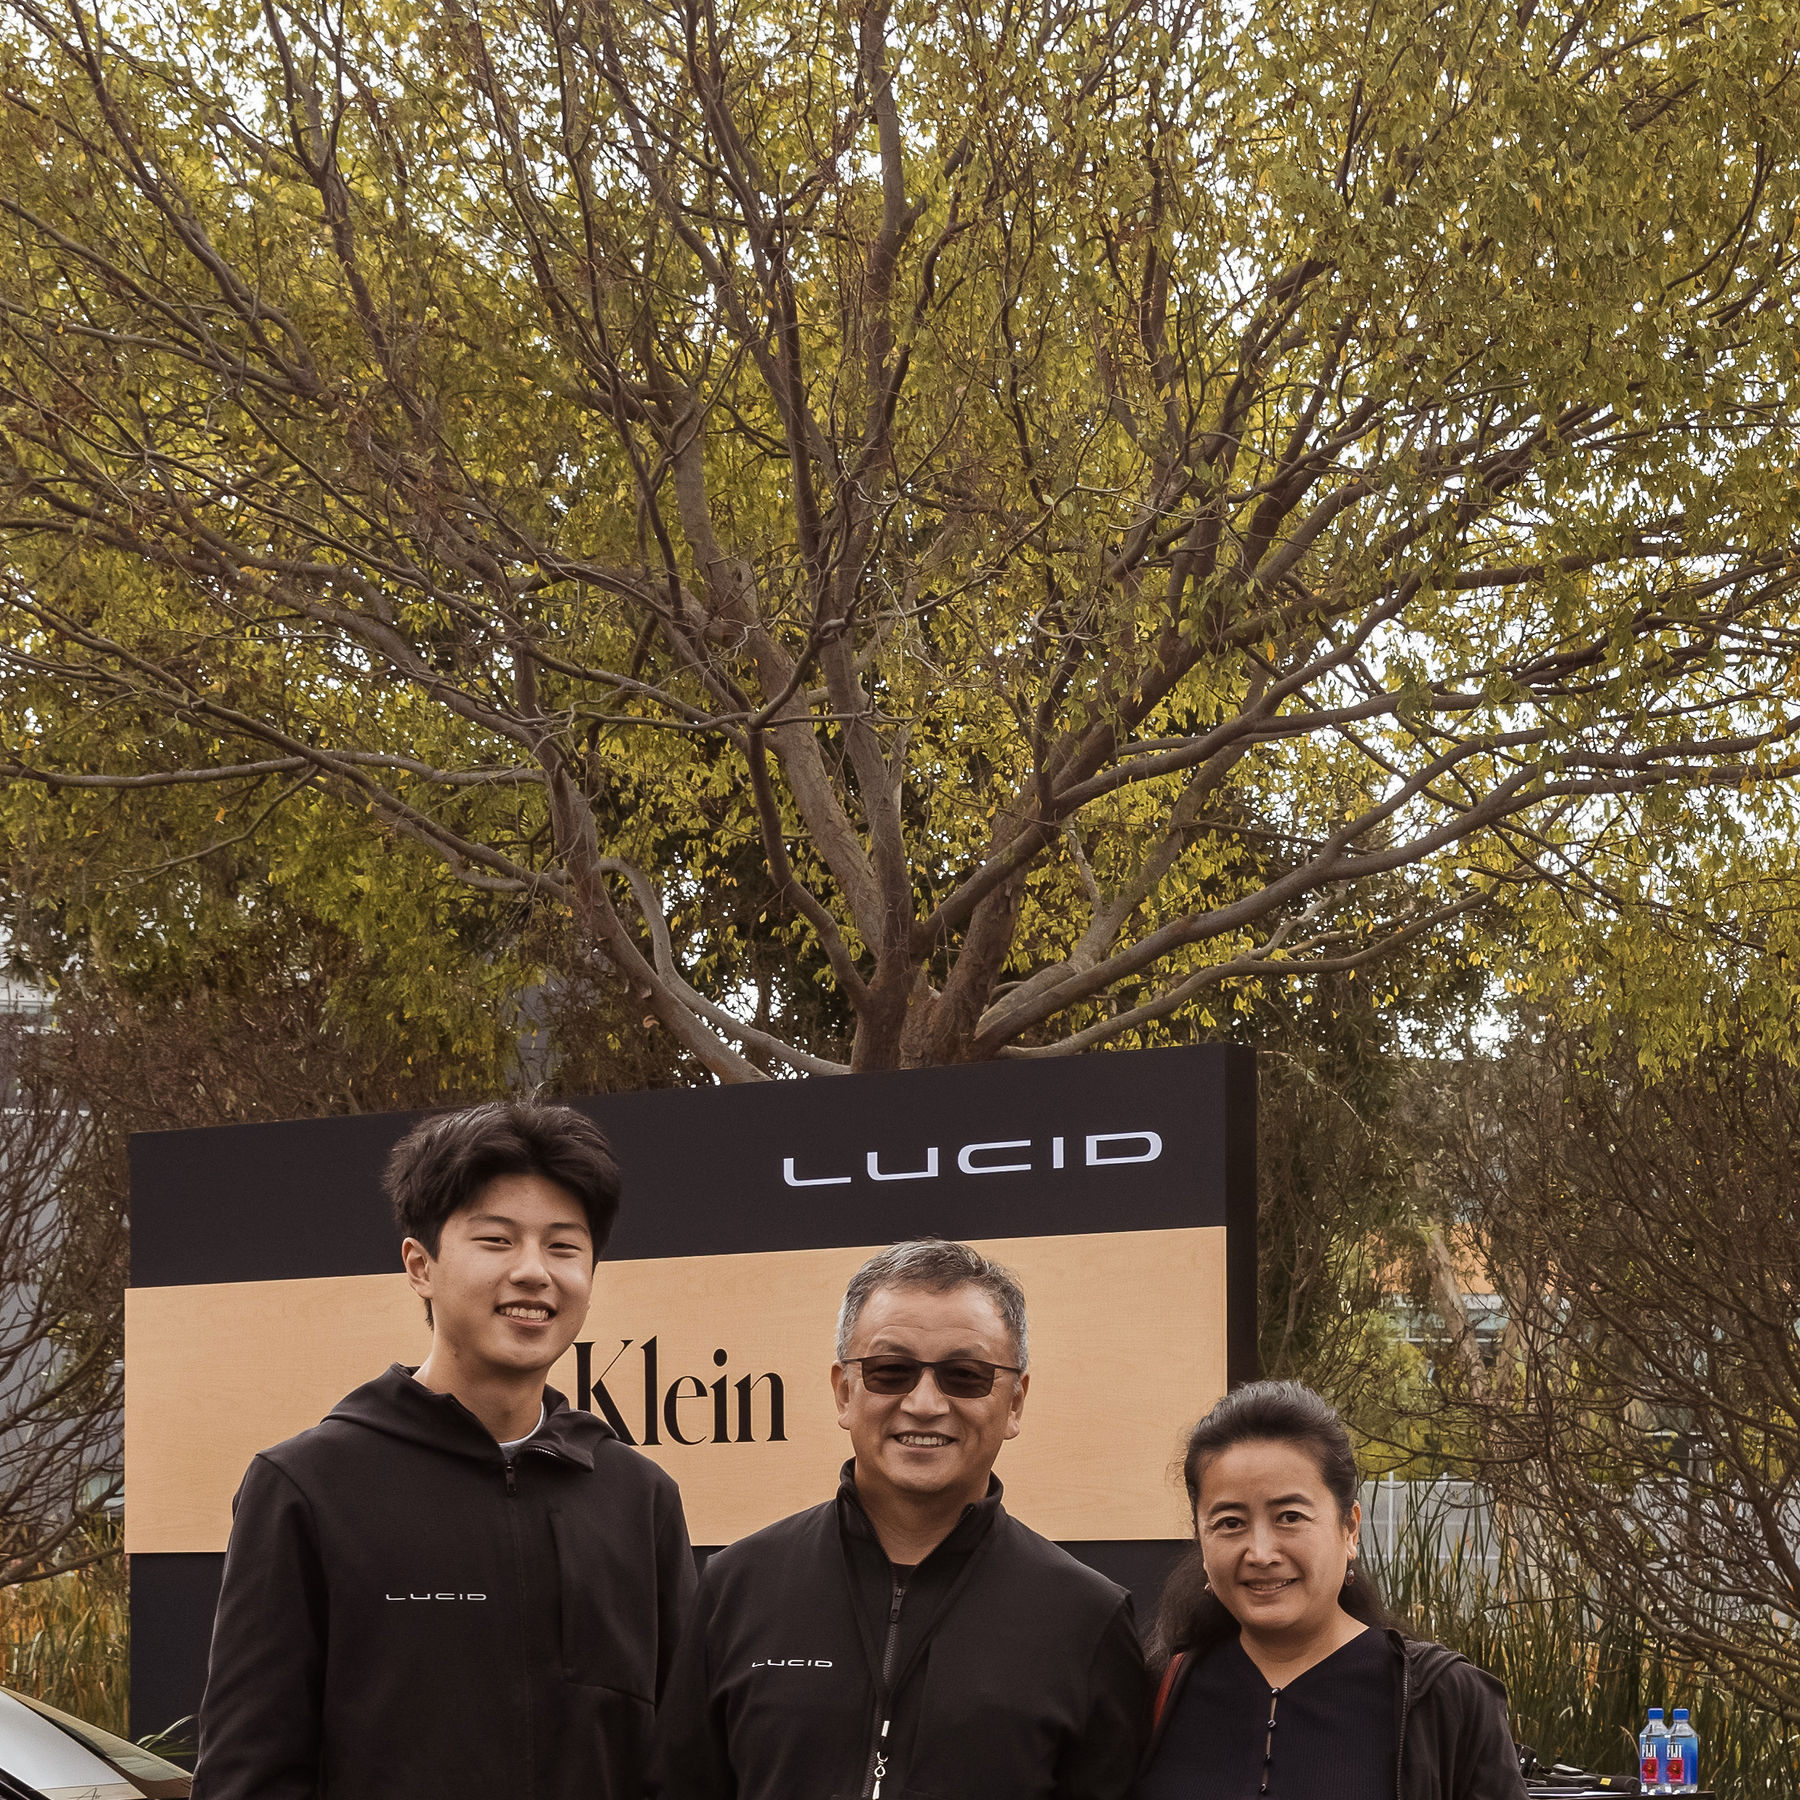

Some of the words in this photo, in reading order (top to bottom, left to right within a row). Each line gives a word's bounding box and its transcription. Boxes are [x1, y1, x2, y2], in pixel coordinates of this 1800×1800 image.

[783, 1131, 1163, 1187] LUCID
[573, 1335, 789, 1446] Klein
[385, 1592, 487, 1601] LUCID
[751, 1659, 833, 1668] LUCID
[1641, 1744, 1656, 1758] FIJI
[1666, 1744, 1682, 1758] FIJI
